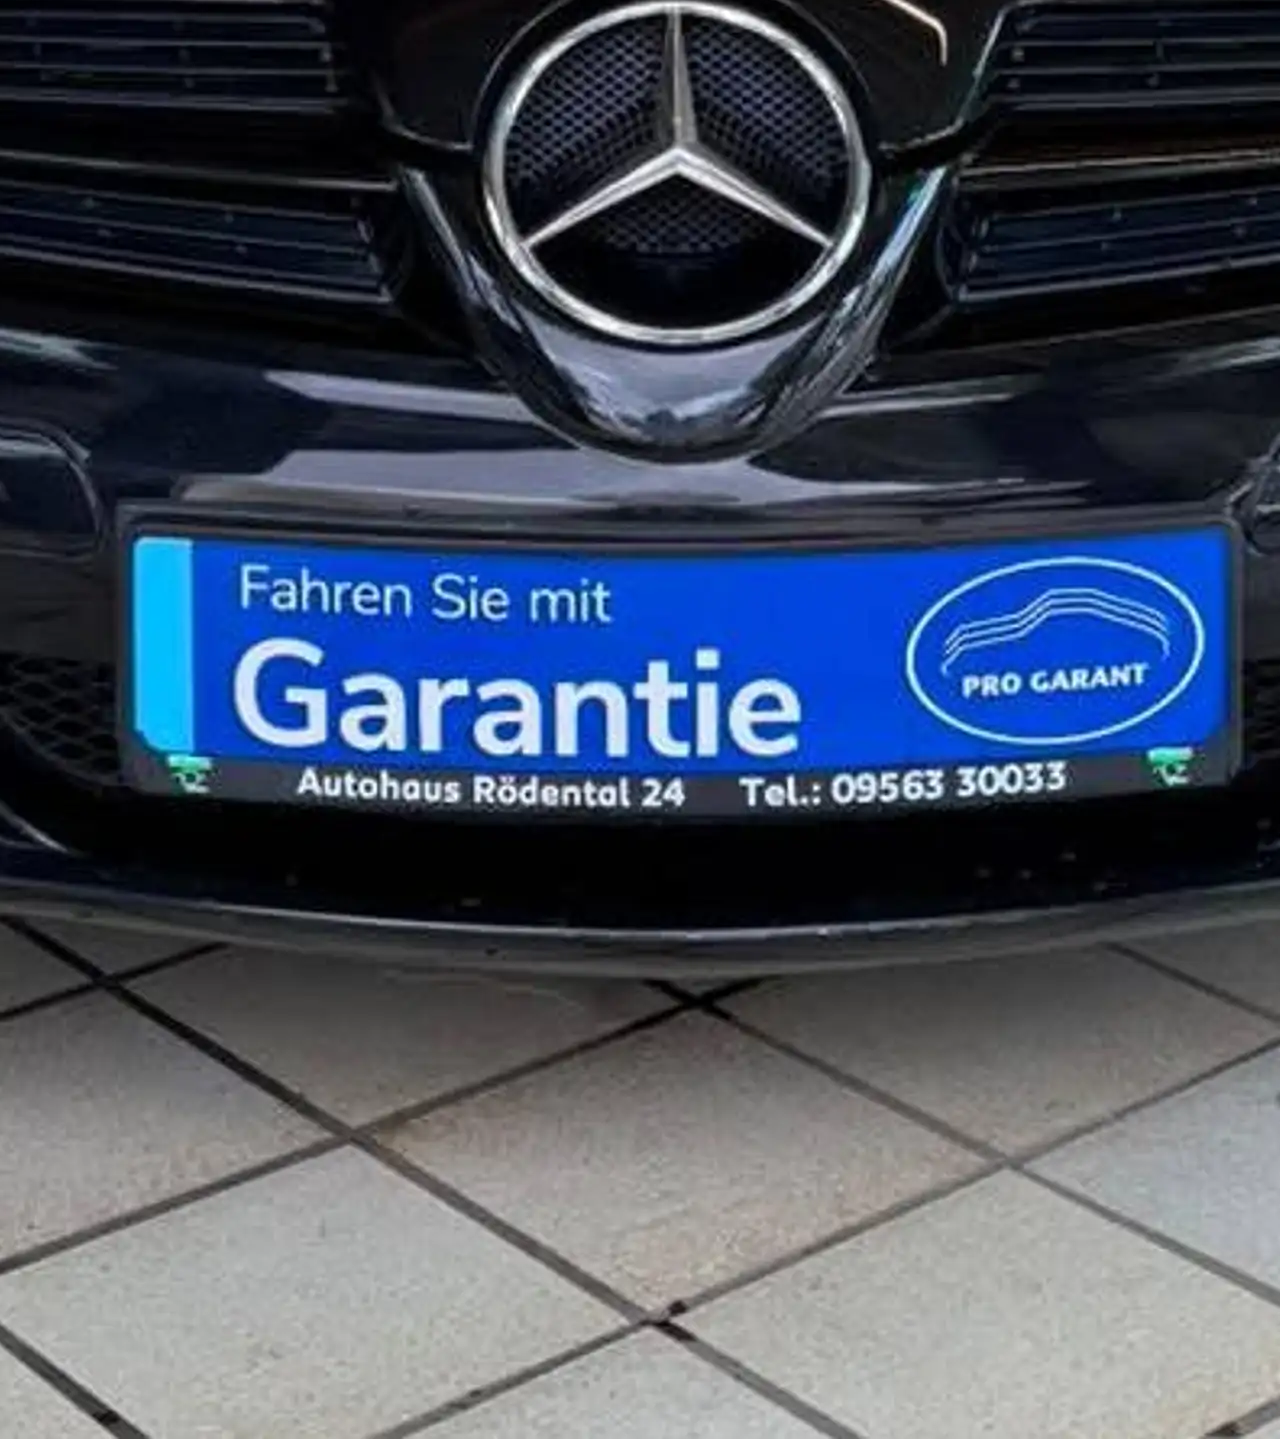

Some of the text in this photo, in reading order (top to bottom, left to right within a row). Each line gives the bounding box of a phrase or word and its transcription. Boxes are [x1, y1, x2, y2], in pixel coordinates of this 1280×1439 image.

[239, 563, 613, 623] Fahren Sie mit
[233, 637, 801, 758] Garantie
[962, 663, 1148, 699] PRO GARANT
[296, 761, 1068, 808] Autohaus Rödental 24 Tel.: 09563 30033
